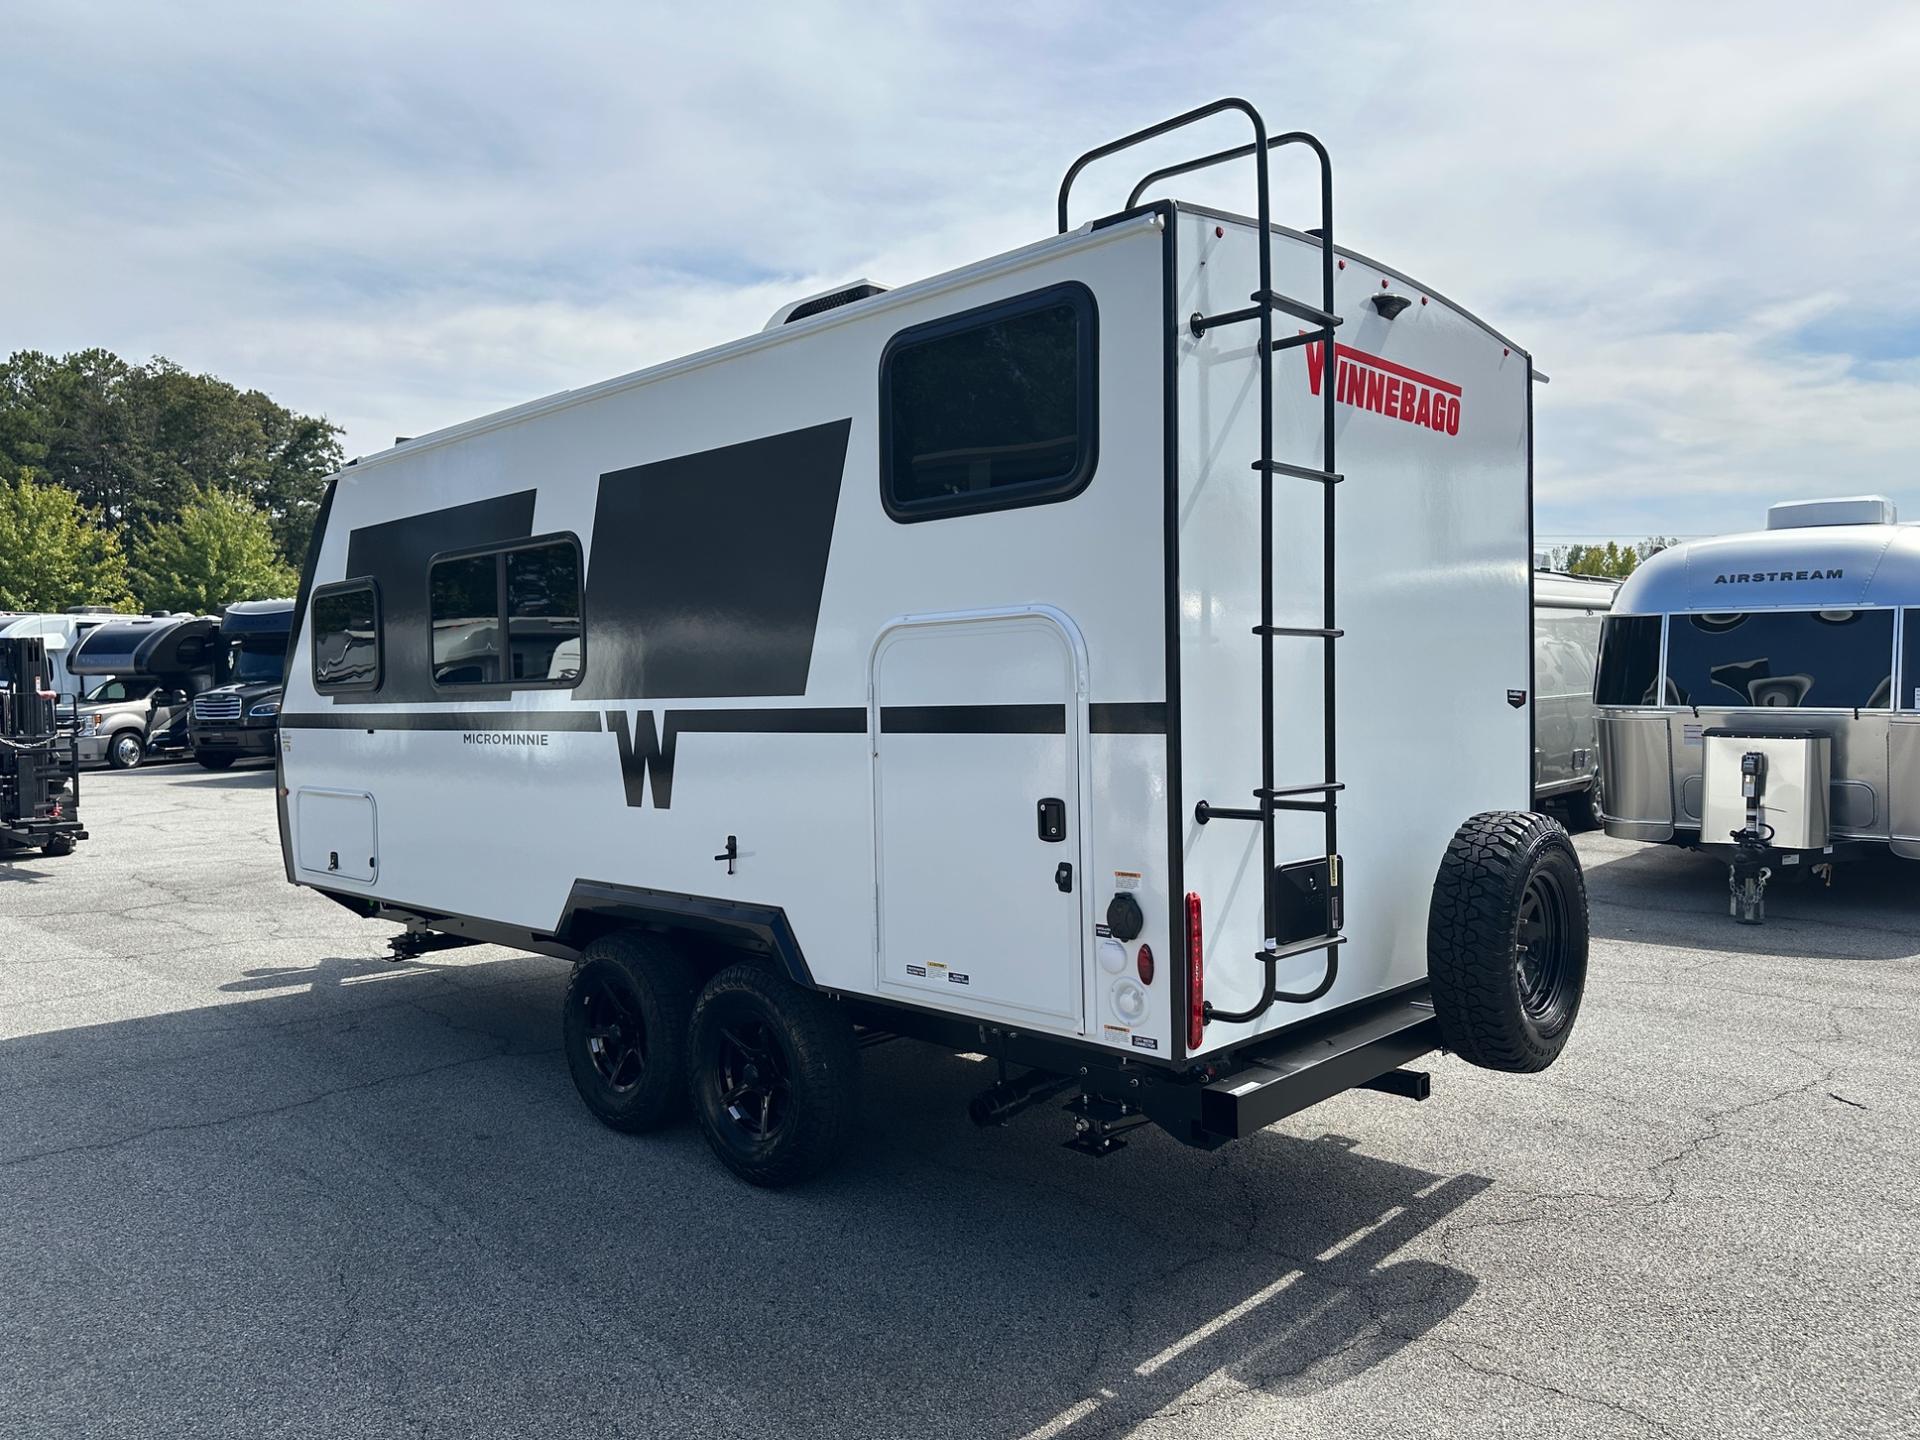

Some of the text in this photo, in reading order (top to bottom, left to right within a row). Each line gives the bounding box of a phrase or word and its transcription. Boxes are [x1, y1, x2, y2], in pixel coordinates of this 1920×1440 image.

[1714, 569, 1843, 584] AIRSTREAM
[463, 733, 549, 746] MICROMINNIE
[605, 709, 678, 810] W
